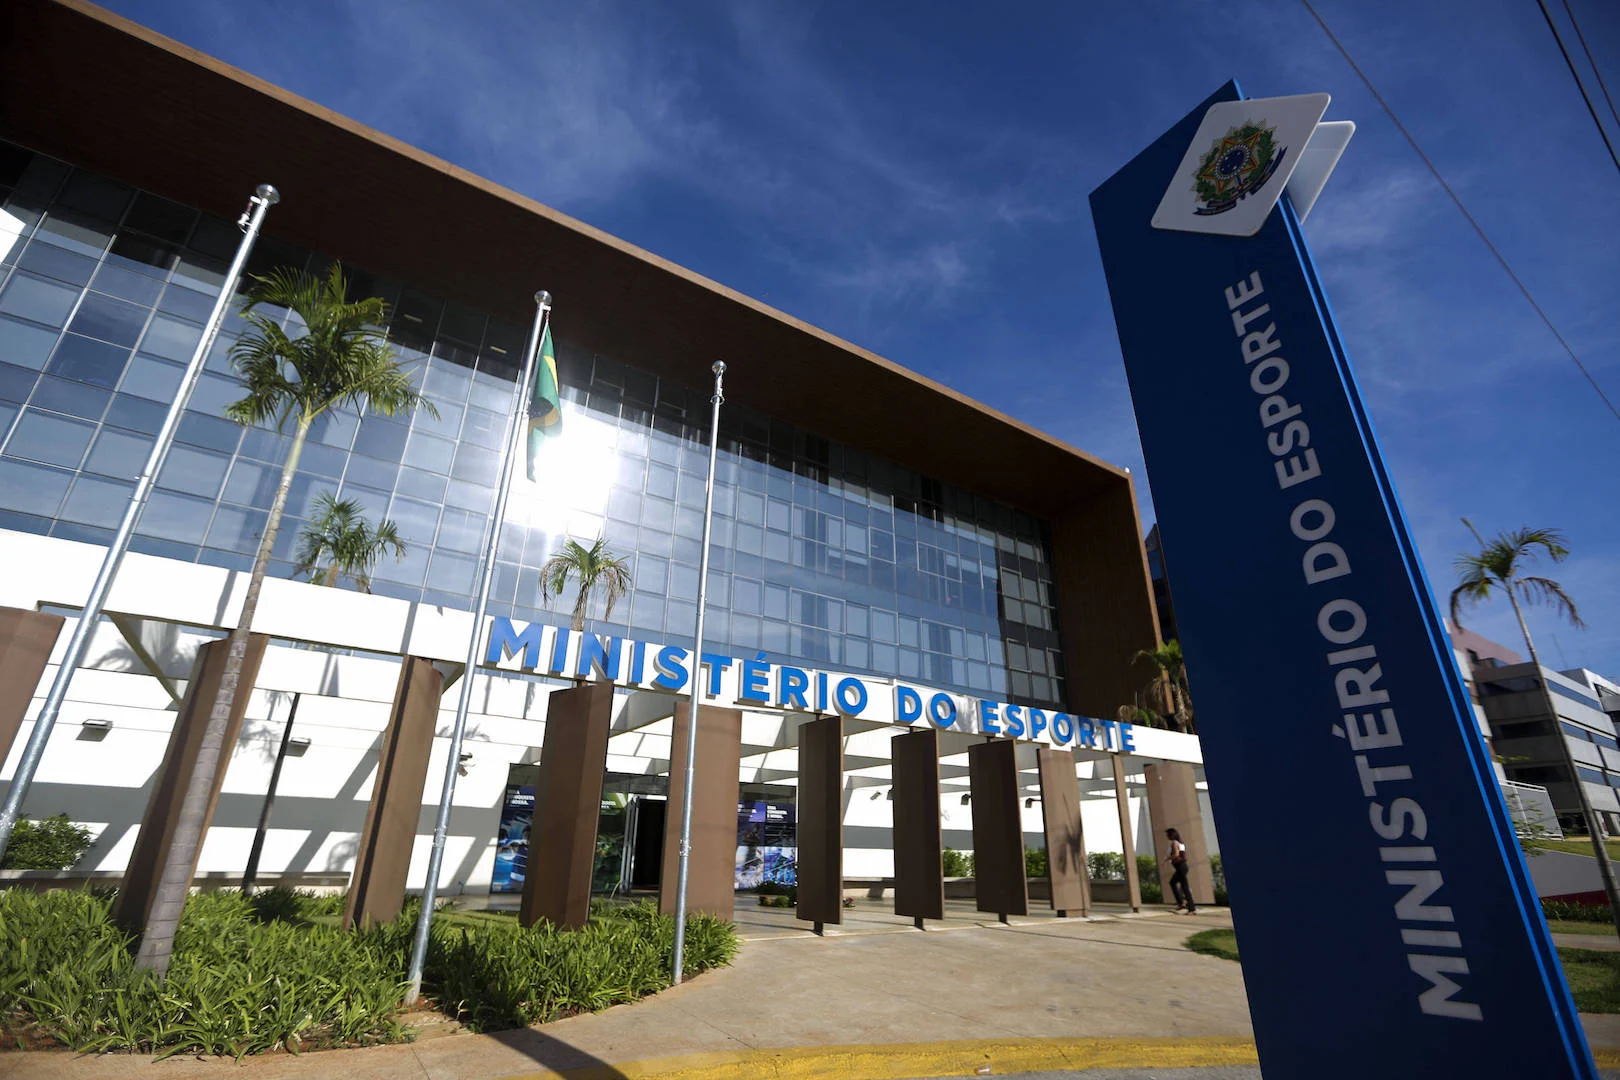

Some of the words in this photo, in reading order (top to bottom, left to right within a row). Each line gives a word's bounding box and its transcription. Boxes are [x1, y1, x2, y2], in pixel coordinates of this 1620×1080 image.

[1224, 270, 1322, 490] ESPORTE
[1290, 499, 1352, 585] DO
[486, 616, 868, 716] MINISTÉRIO
[895, 685, 957, 729] DO
[978, 699, 1137, 752] ESPORTE
[1317, 598, 1484, 1021] MINISTÉRIO
